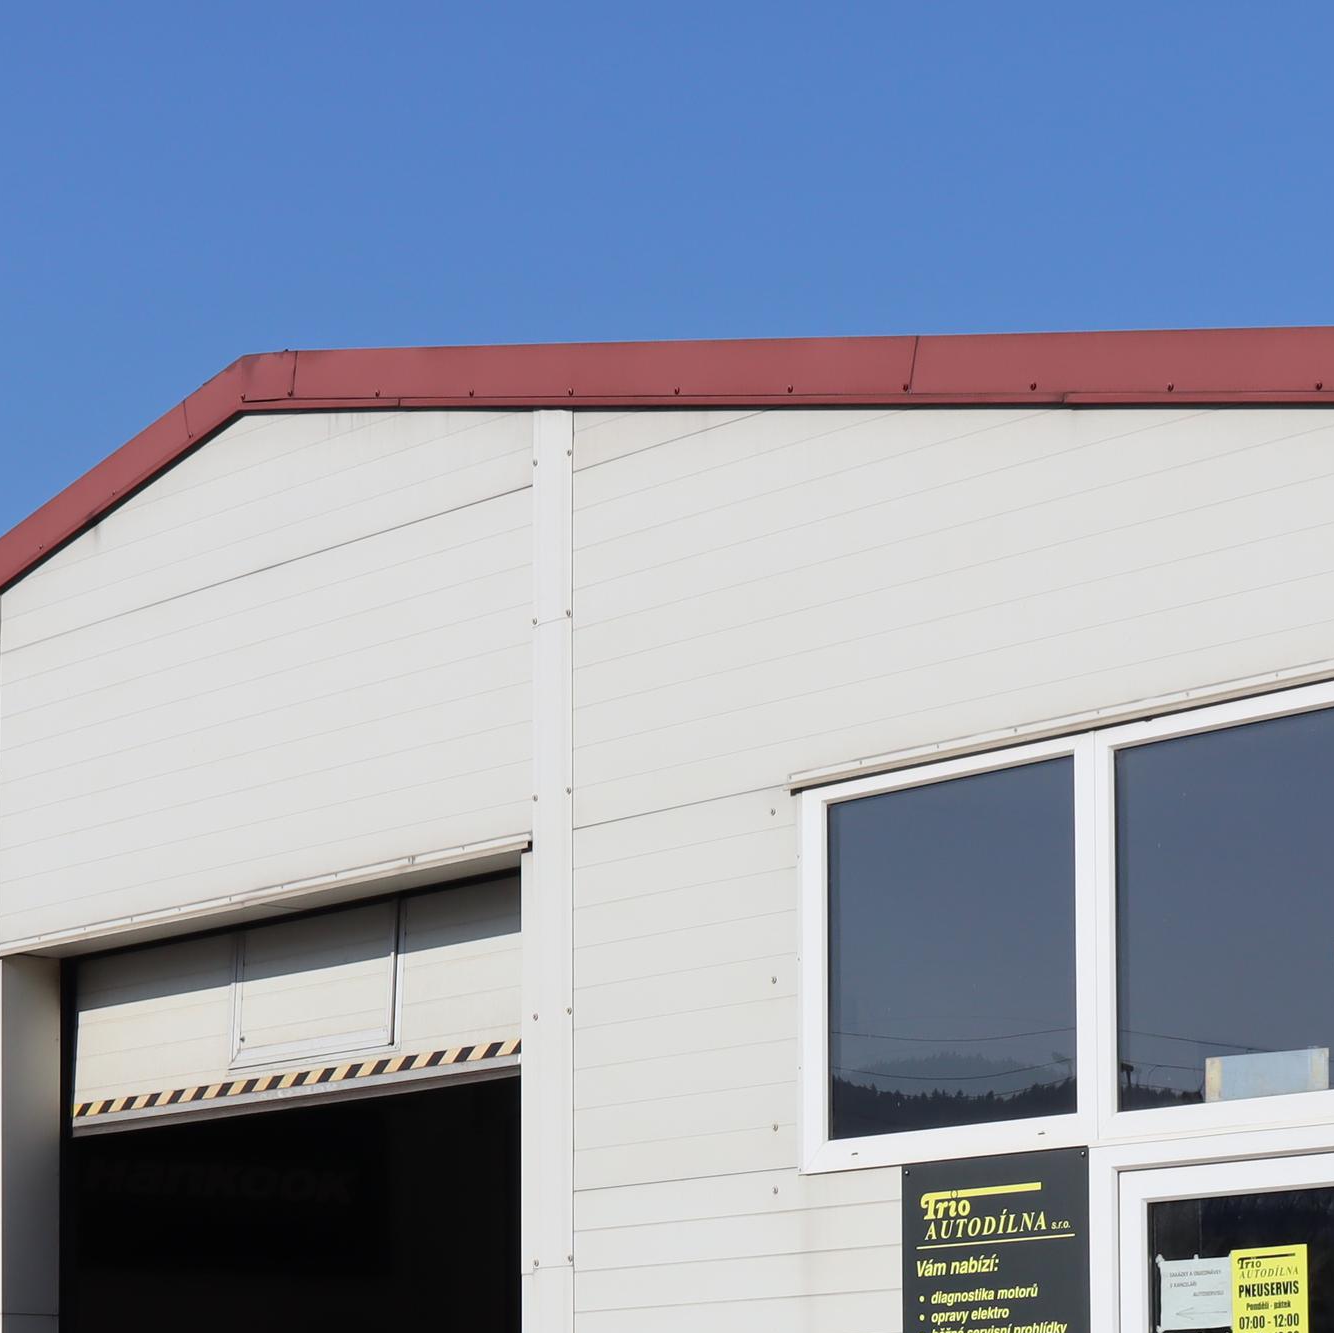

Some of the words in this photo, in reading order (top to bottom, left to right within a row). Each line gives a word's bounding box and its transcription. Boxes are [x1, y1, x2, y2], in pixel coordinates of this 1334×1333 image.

[924, 1209, 1047, 1240] AUTODÍLNA
[1051, 1221, 1071, 1230] s.r.o.
[917, 1259, 946, 1277] Vám
[950, 1253, 999, 1276] nabízí:
[931, 1286, 994, 1306] diagnostika
[1238, 1280, 1299, 1298] PNEUSERVIS
[931, 1309, 969, 1325] opravy
[971, 1306, 1010, 1320] elektro
[1239, 1315, 1265, 1330] 07:00
[1273, 1313, 1299, 1327] 12:00
